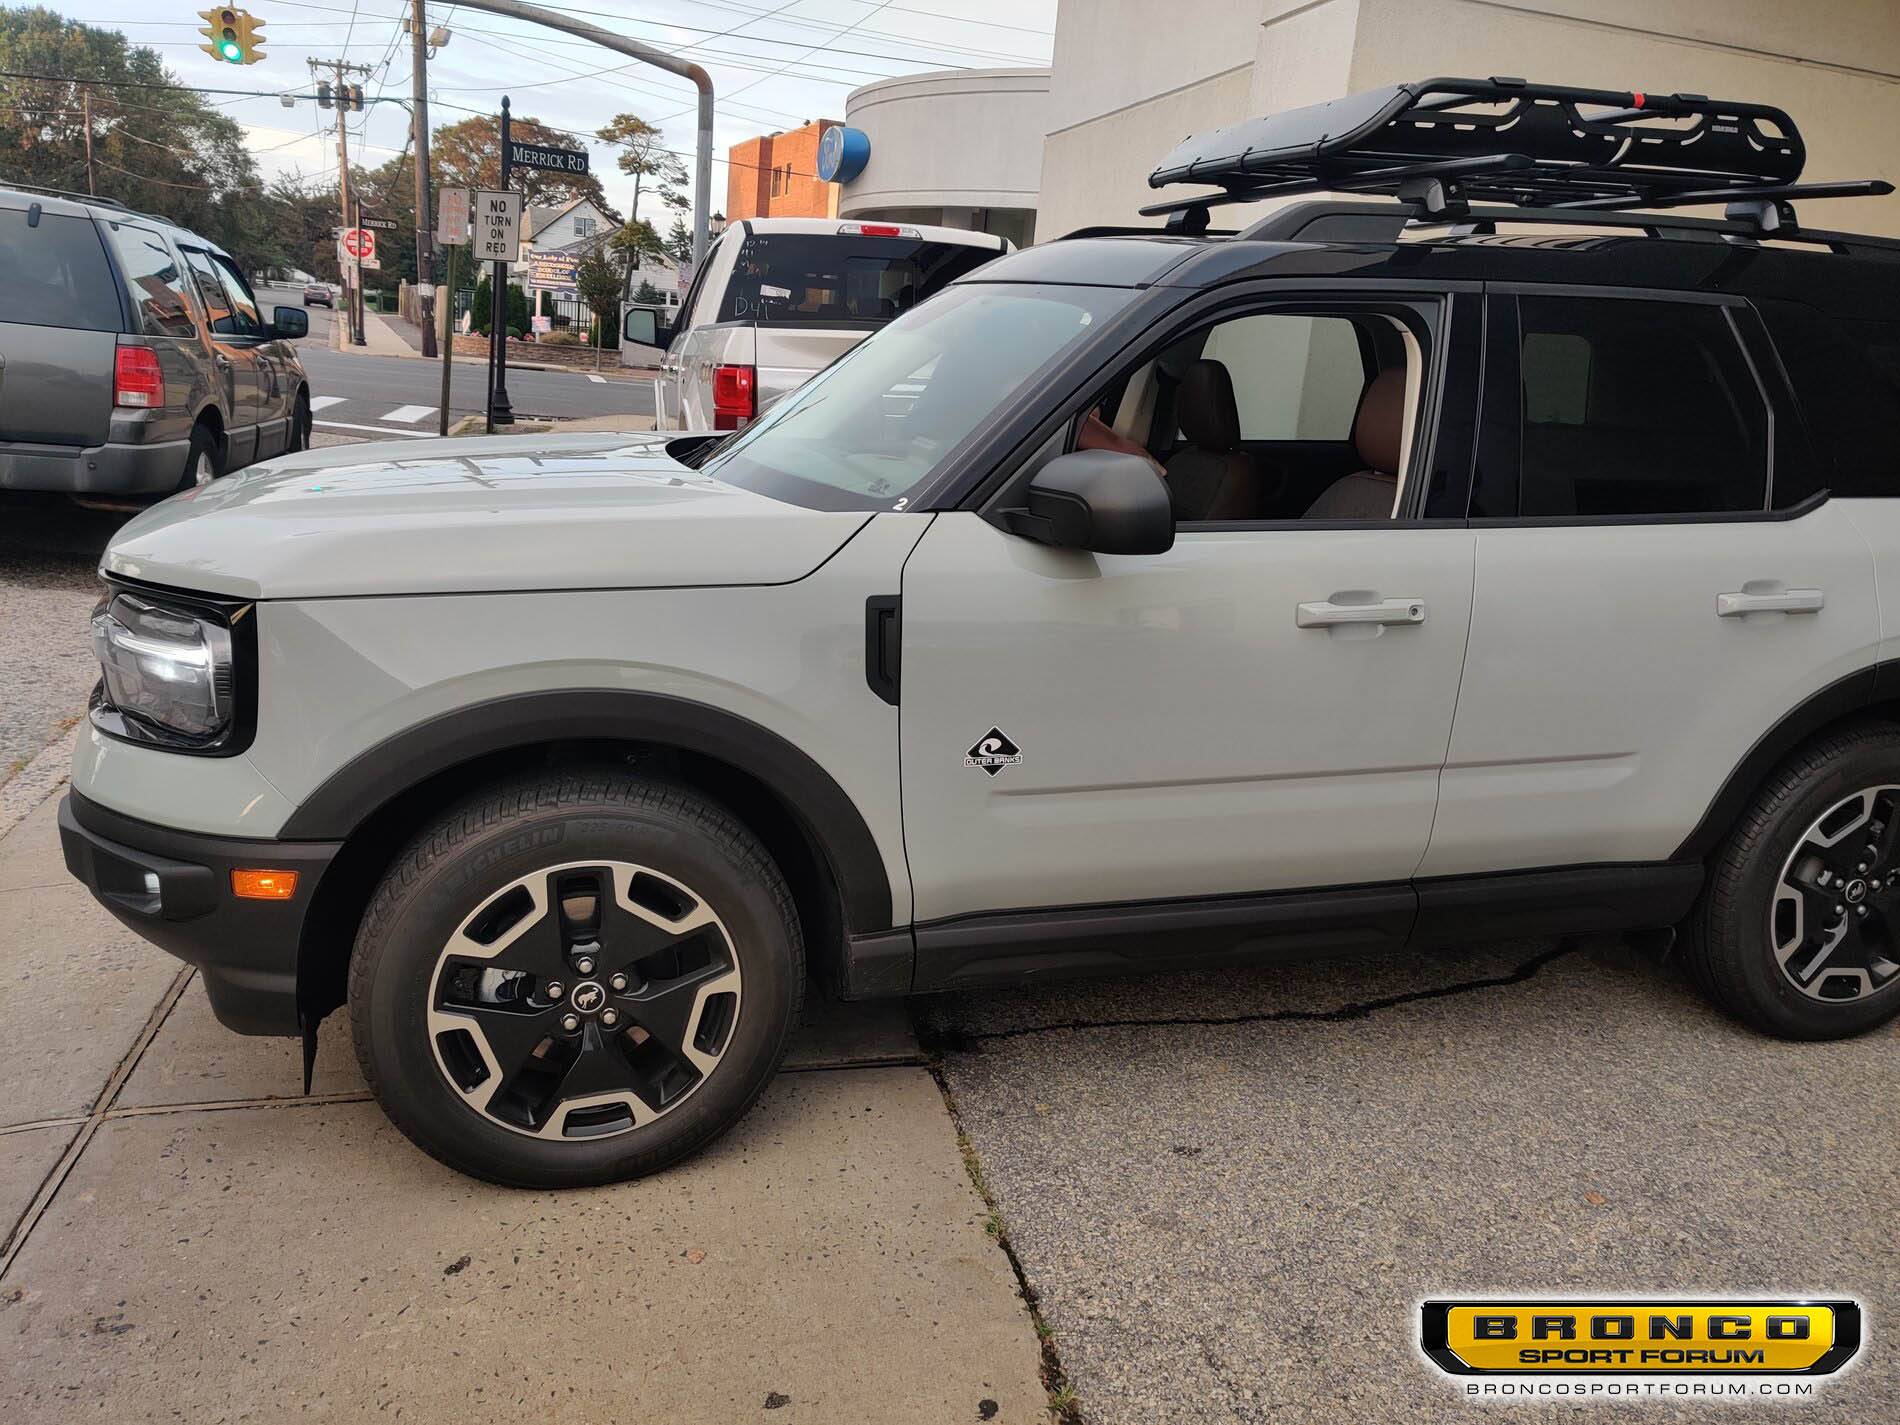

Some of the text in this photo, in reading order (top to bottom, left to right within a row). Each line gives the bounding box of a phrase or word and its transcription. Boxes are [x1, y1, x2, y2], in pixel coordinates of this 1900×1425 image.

[512, 146, 585, 172] MERRICK RD
[490, 199, 507, 213] NO
[484, 215, 512, 227] TURN
[490, 228, 504, 239] ON
[485, 241, 506, 254] RED
[892, 497, 909, 511] 2
[966, 756, 1020, 766] OUTER BANKS
